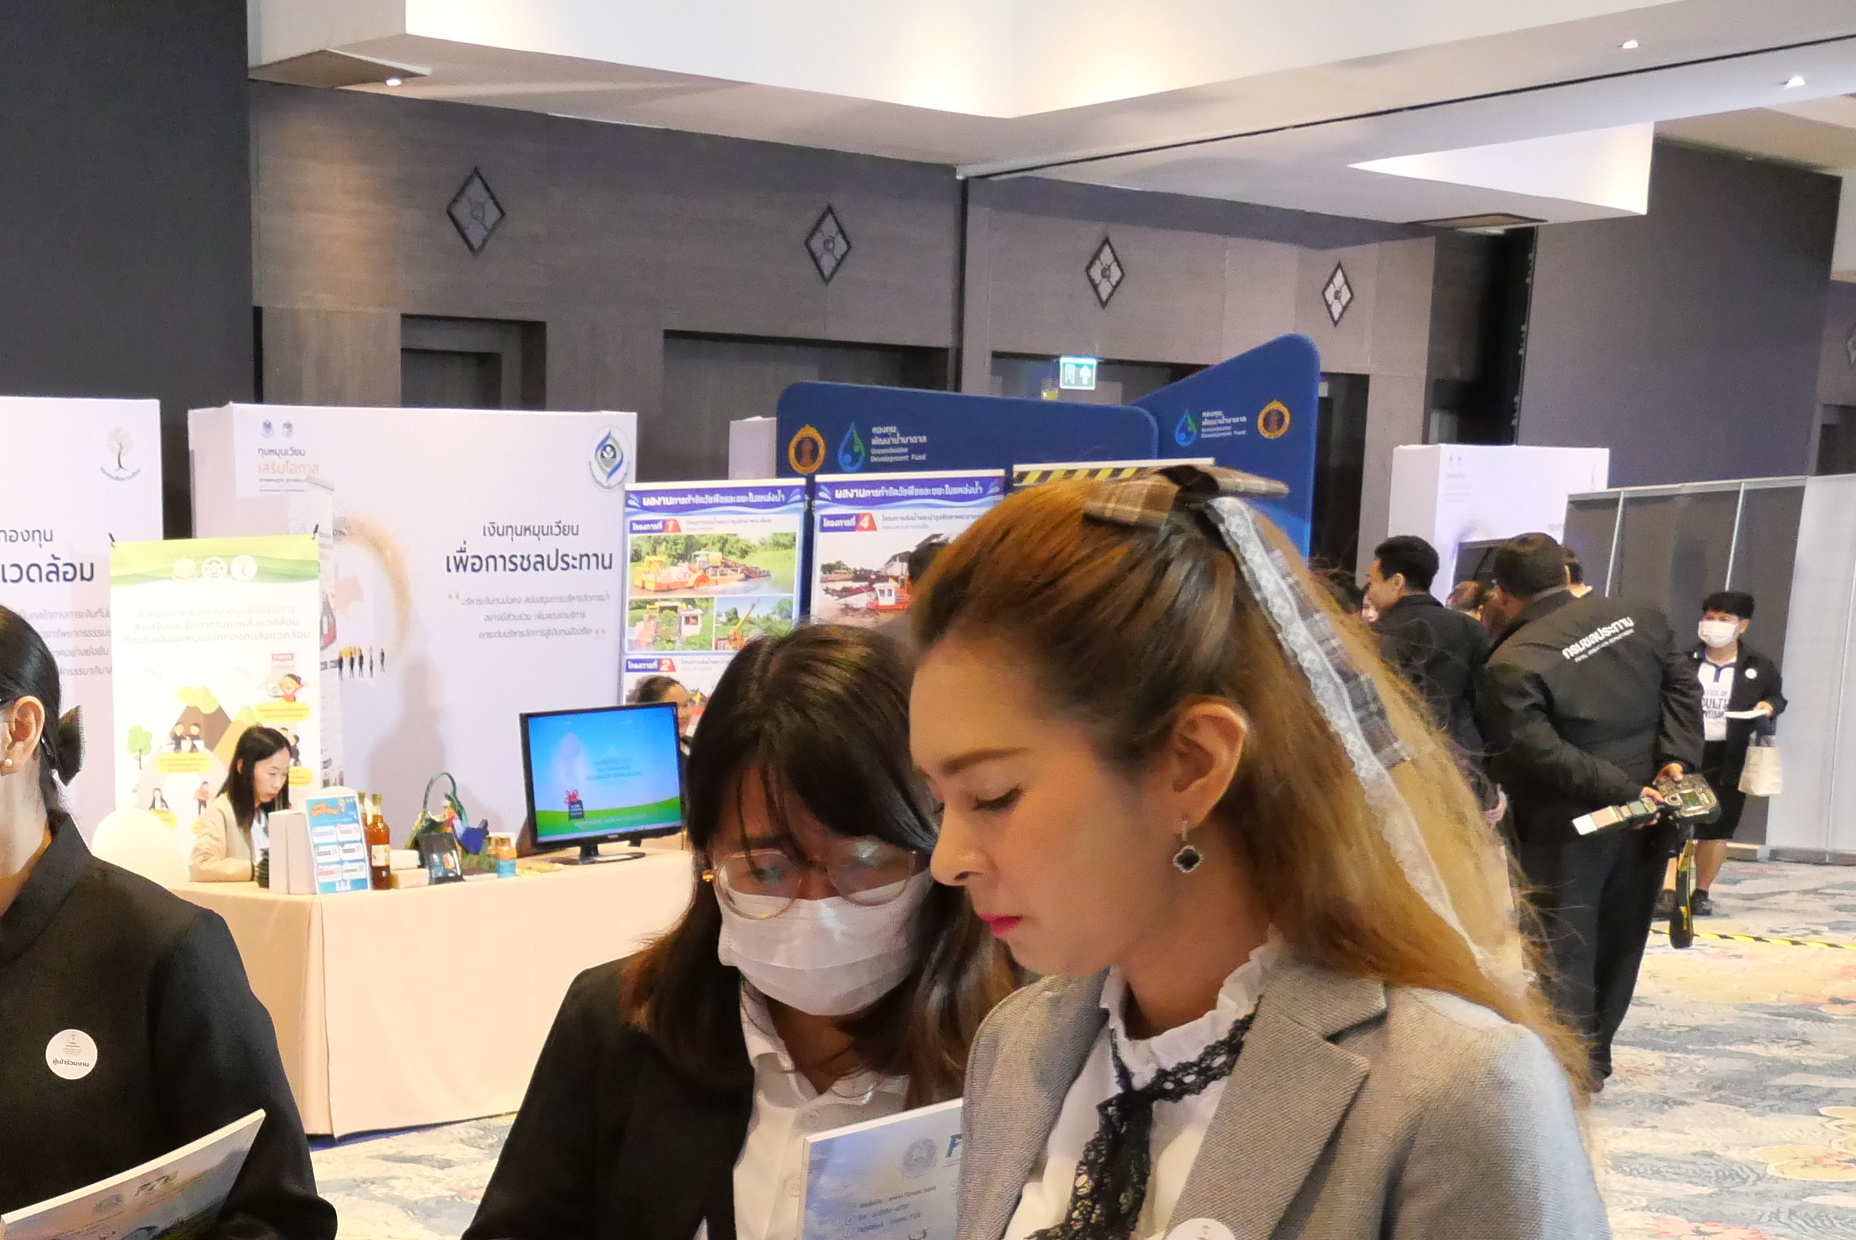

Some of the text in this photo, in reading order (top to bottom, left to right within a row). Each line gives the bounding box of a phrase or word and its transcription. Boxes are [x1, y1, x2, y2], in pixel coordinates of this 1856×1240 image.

[257, 447, 306, 459] ทุนหมุนเวียน
[483, 519, 579, 542] เงินทุนหมุนเวียน
[859, 517, 871, 529] 4
[446, 540, 613, 573] เพื่อการชลประทาน
[1562, 616, 1635, 660] กรมชลประทาน
[660, 661, 671, 671] 2
